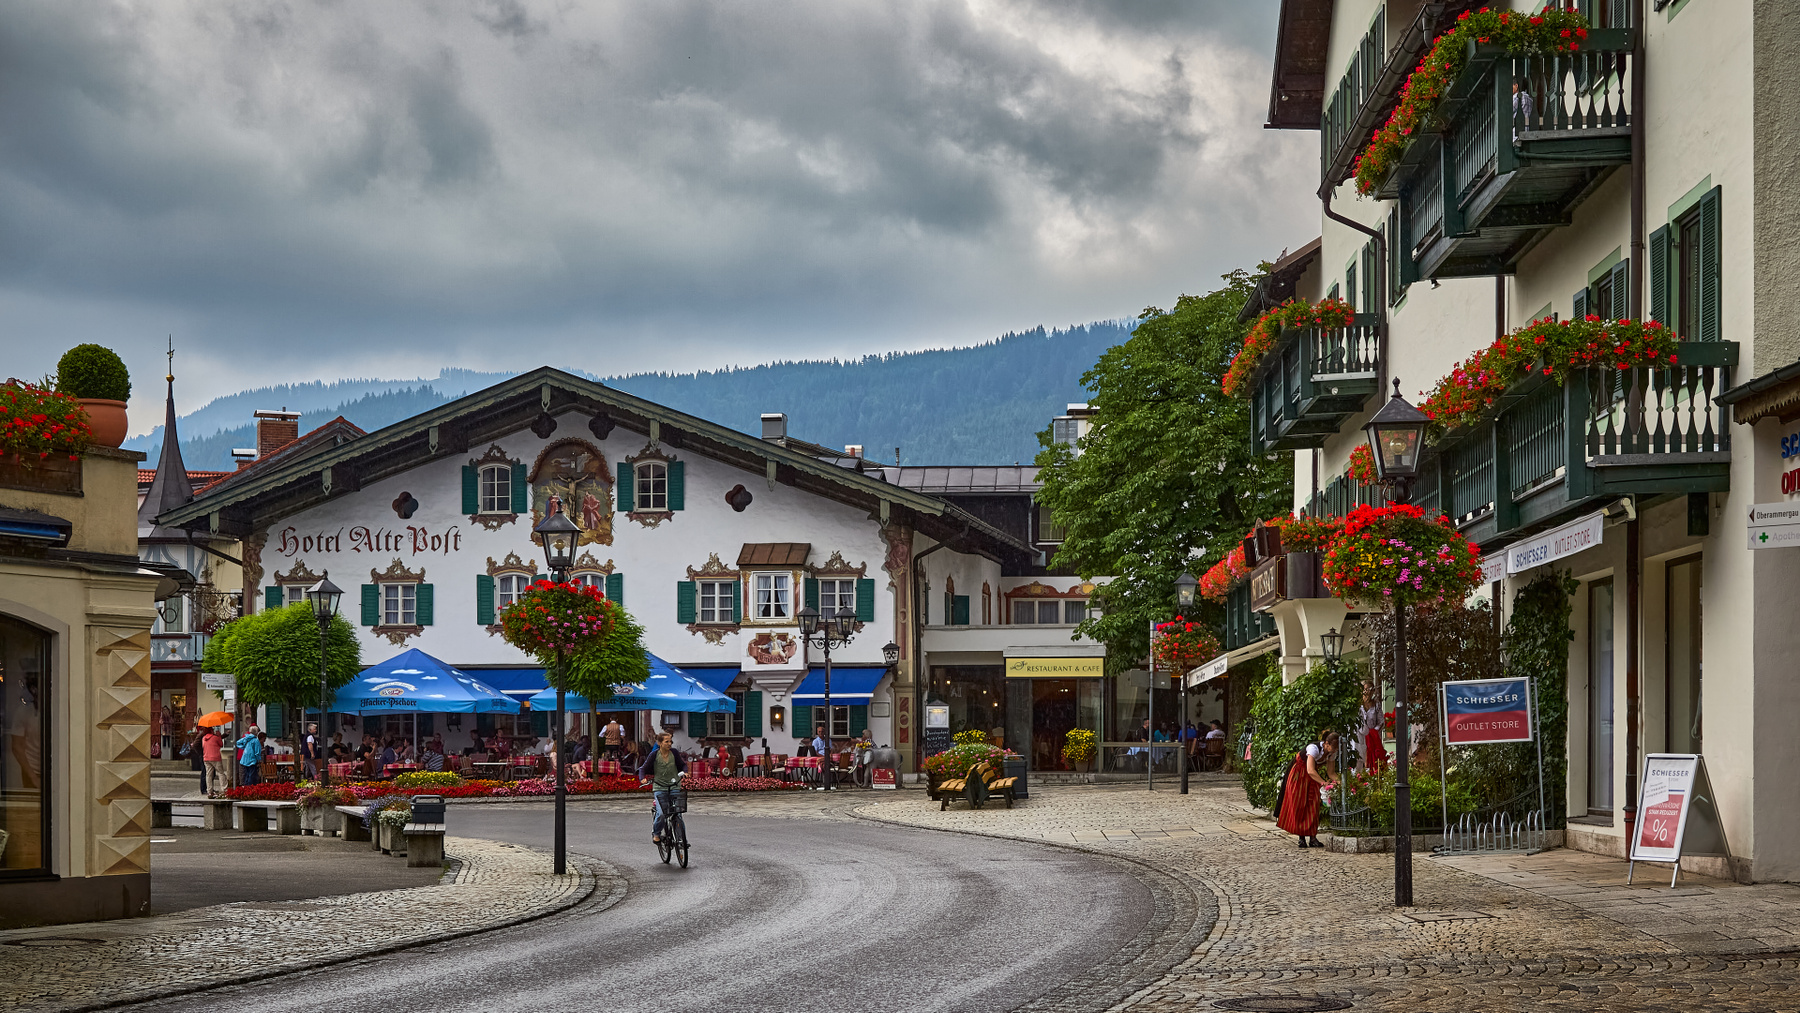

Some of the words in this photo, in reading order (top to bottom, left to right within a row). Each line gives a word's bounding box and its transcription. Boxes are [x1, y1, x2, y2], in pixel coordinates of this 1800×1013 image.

[1781, 433, 1800, 459] SC
[1756, 510, 1799, 520] Oberammergau
[276, 526, 344, 557] Hotel
[349, 526, 404, 553] Alte
[1516, 544, 1548, 568] SCHIESSER
[1554, 534, 1573, 555] OUTLET
[1573, 528, 1591, 549] STORE
[1456, 693, 1518, 705] SCHIESSER
[1456, 722, 1490, 731] OUTLET
[1491, 720, 1520, 730] STORE
[1651, 769, 1689, 777] SCHIESSER
